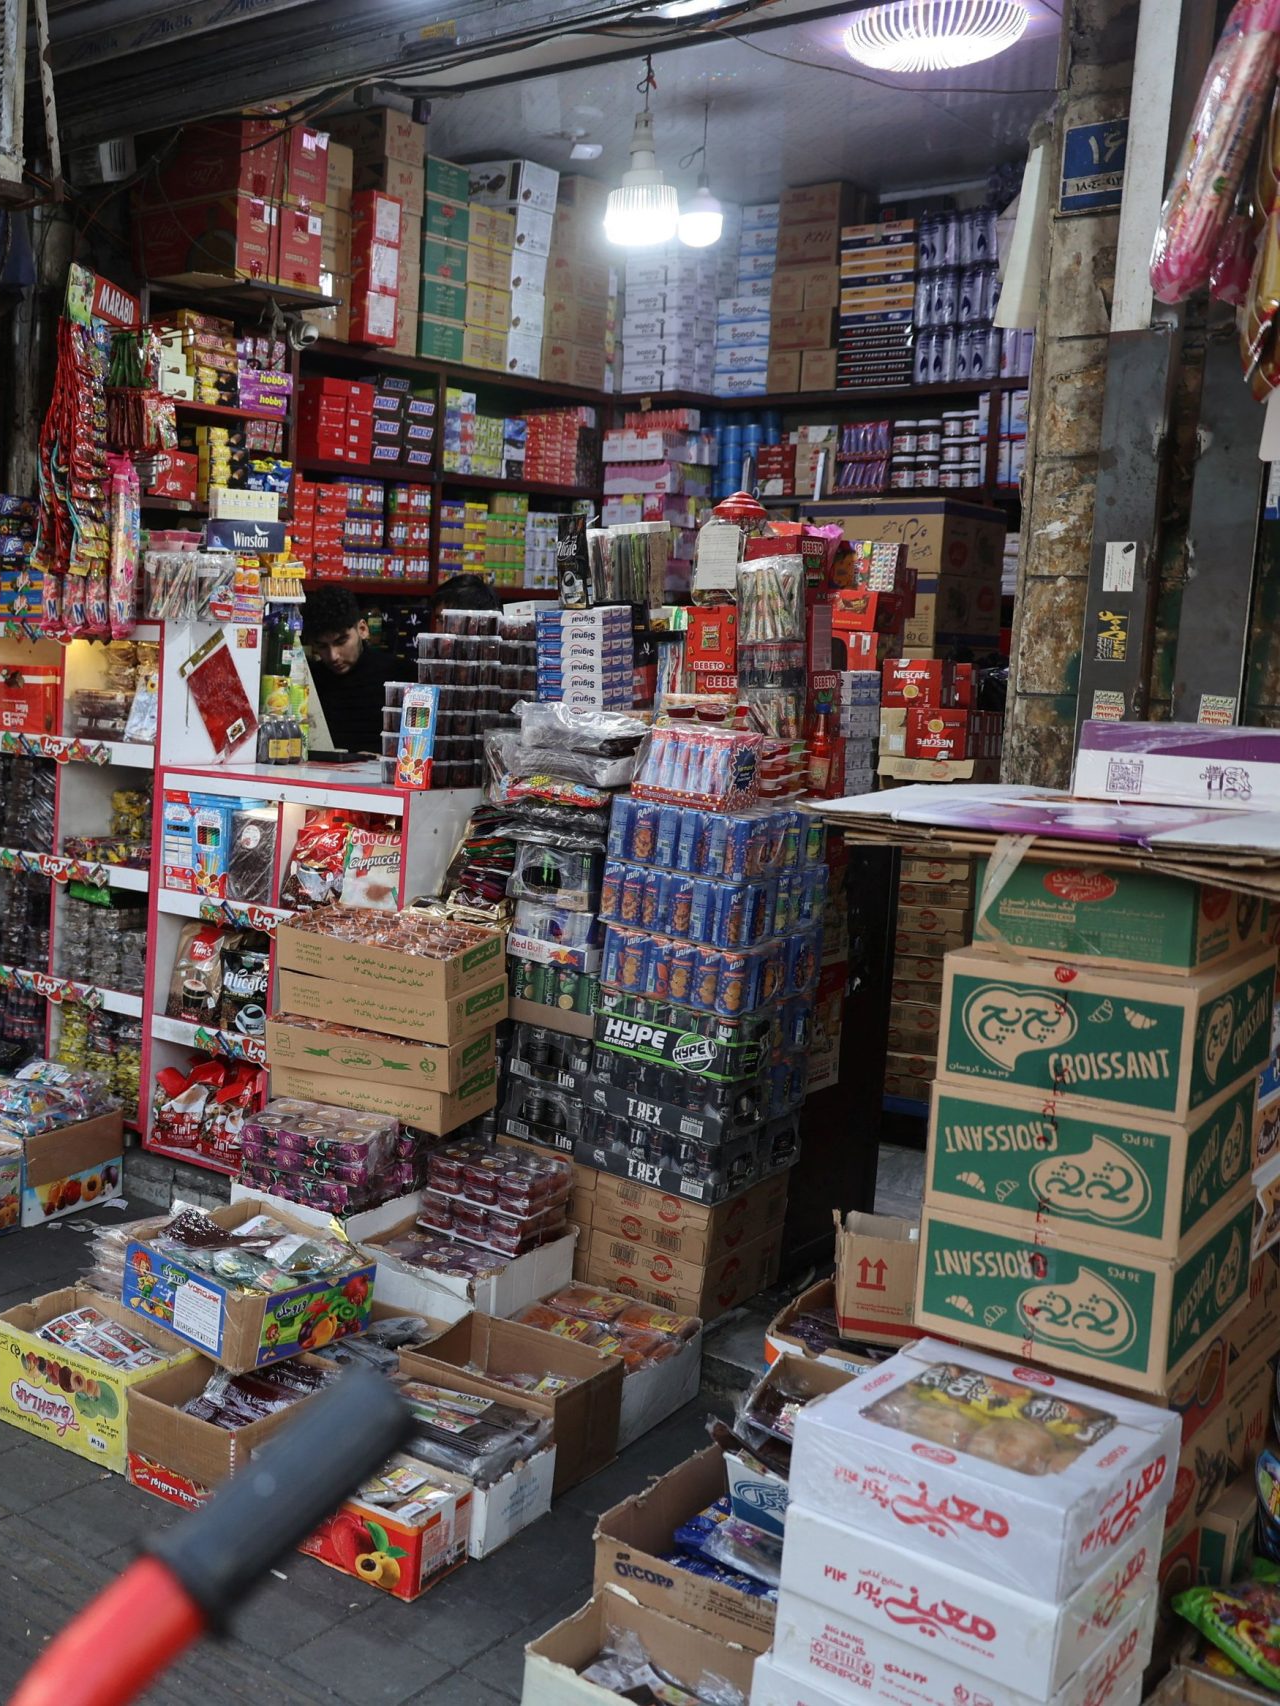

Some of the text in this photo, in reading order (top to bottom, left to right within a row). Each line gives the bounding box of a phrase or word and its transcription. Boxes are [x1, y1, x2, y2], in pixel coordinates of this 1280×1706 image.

[99, 283, 134, 325] MARABO
[260, 373, 288, 388] hobby
[384, 378, 409, 391] SNICKERS
[259, 395, 283, 408] hobby
[374, 396, 399, 409] SNICKERS
[410, 401, 435, 415] SNICKERS
[375, 421, 399, 434] SNICKERS
[408, 426, 433, 439] SNICKERS
[374, 447, 400, 460] SNICKERS
[409, 452, 432, 464] SNICKERS
[233, 530, 269, 548] Winston
[801, 540, 824, 555] BEBETO
[571, 615, 596, 624] Signal
[571, 631, 596, 640] Signal
[570, 647, 595, 656] Signal
[571, 664, 595, 672] Signal
[693, 662, 725, 670] BEBETO
[571, 680, 595, 688] Signal
[707, 675, 737, 688] BEBE
[814, 675, 836, 689] BEBETO
[572, 696, 596, 704] Signal
[193, 941, 211, 957] Tim's
[511, 937, 526, 950] Red
[528, 941, 543, 953] Bull
[223, 971, 268, 992] Alicafé
[605, 1019, 667, 1050] HYPE
[604, 1036, 636, 1048] ENERGY
[674, 1042, 706, 1059] HYPE
[1049, 1049, 1170, 1084] CROISSANT
[558, 1072, 575, 1088] Life
[555, 1133, 572, 1149] Life
[945, 1124, 1058, 1153] CROISSANT
[1122, 1133, 1155, 1148] 36 PCS
[1107, 1267, 1141, 1282] 36 PCS
[16, 1385, 73, 1420] BAGHLAR
[89, 1437, 105, 1450] NEW
[824, 1624, 865, 1646] BIG BANG
[809, 1656, 872, 1690] MOEINIPOUR
